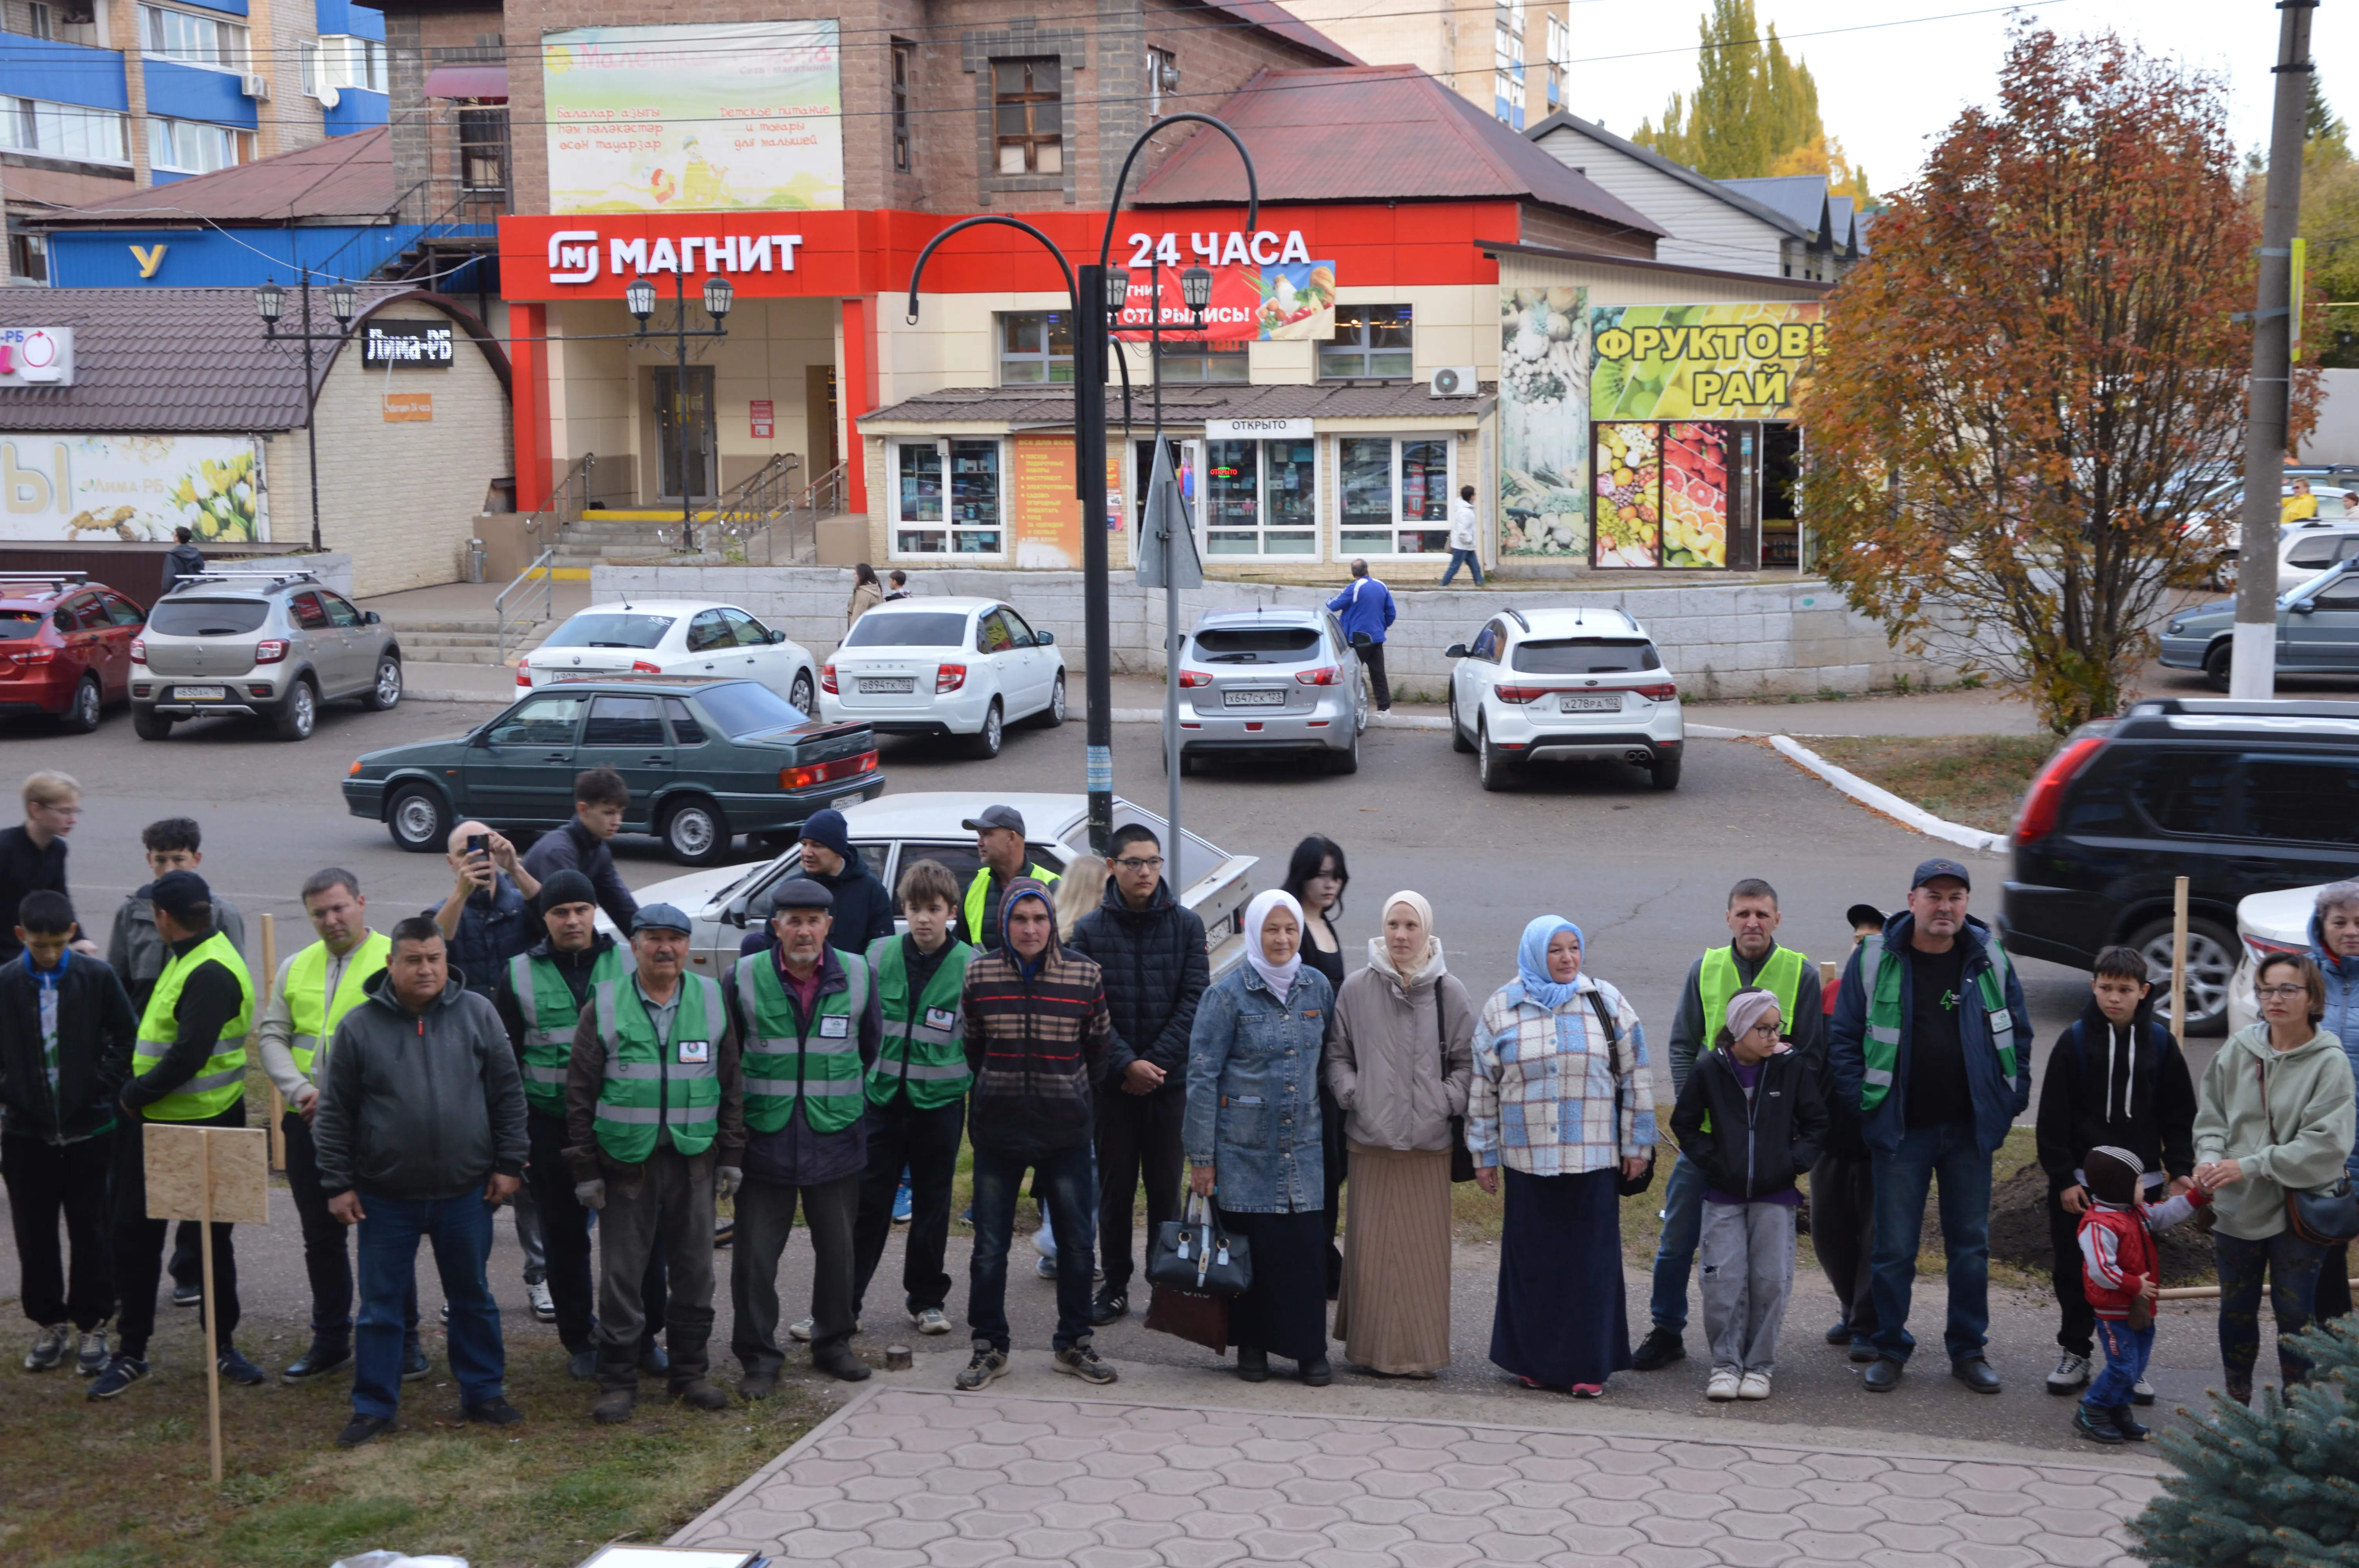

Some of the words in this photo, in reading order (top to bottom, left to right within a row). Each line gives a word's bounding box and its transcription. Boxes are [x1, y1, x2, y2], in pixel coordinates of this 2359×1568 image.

[557, 107, 614, 122] Балалар
[720, 107, 771, 117] Детское
[778, 105, 831, 115] питание
[746, 123, 753, 132] и
[760, 122, 805, 134] товары
[734, 138, 754, 151] для
[761, 134, 818, 147] малышей
[610, 234, 803, 274] МАГНИТ
[1128, 232, 1181, 267] 24
[1191, 230, 1311, 266] ЧАСА
[1694, 363, 1787, 406] РАЙ
[1232, 420, 1287, 430] ОТКРЫТО
